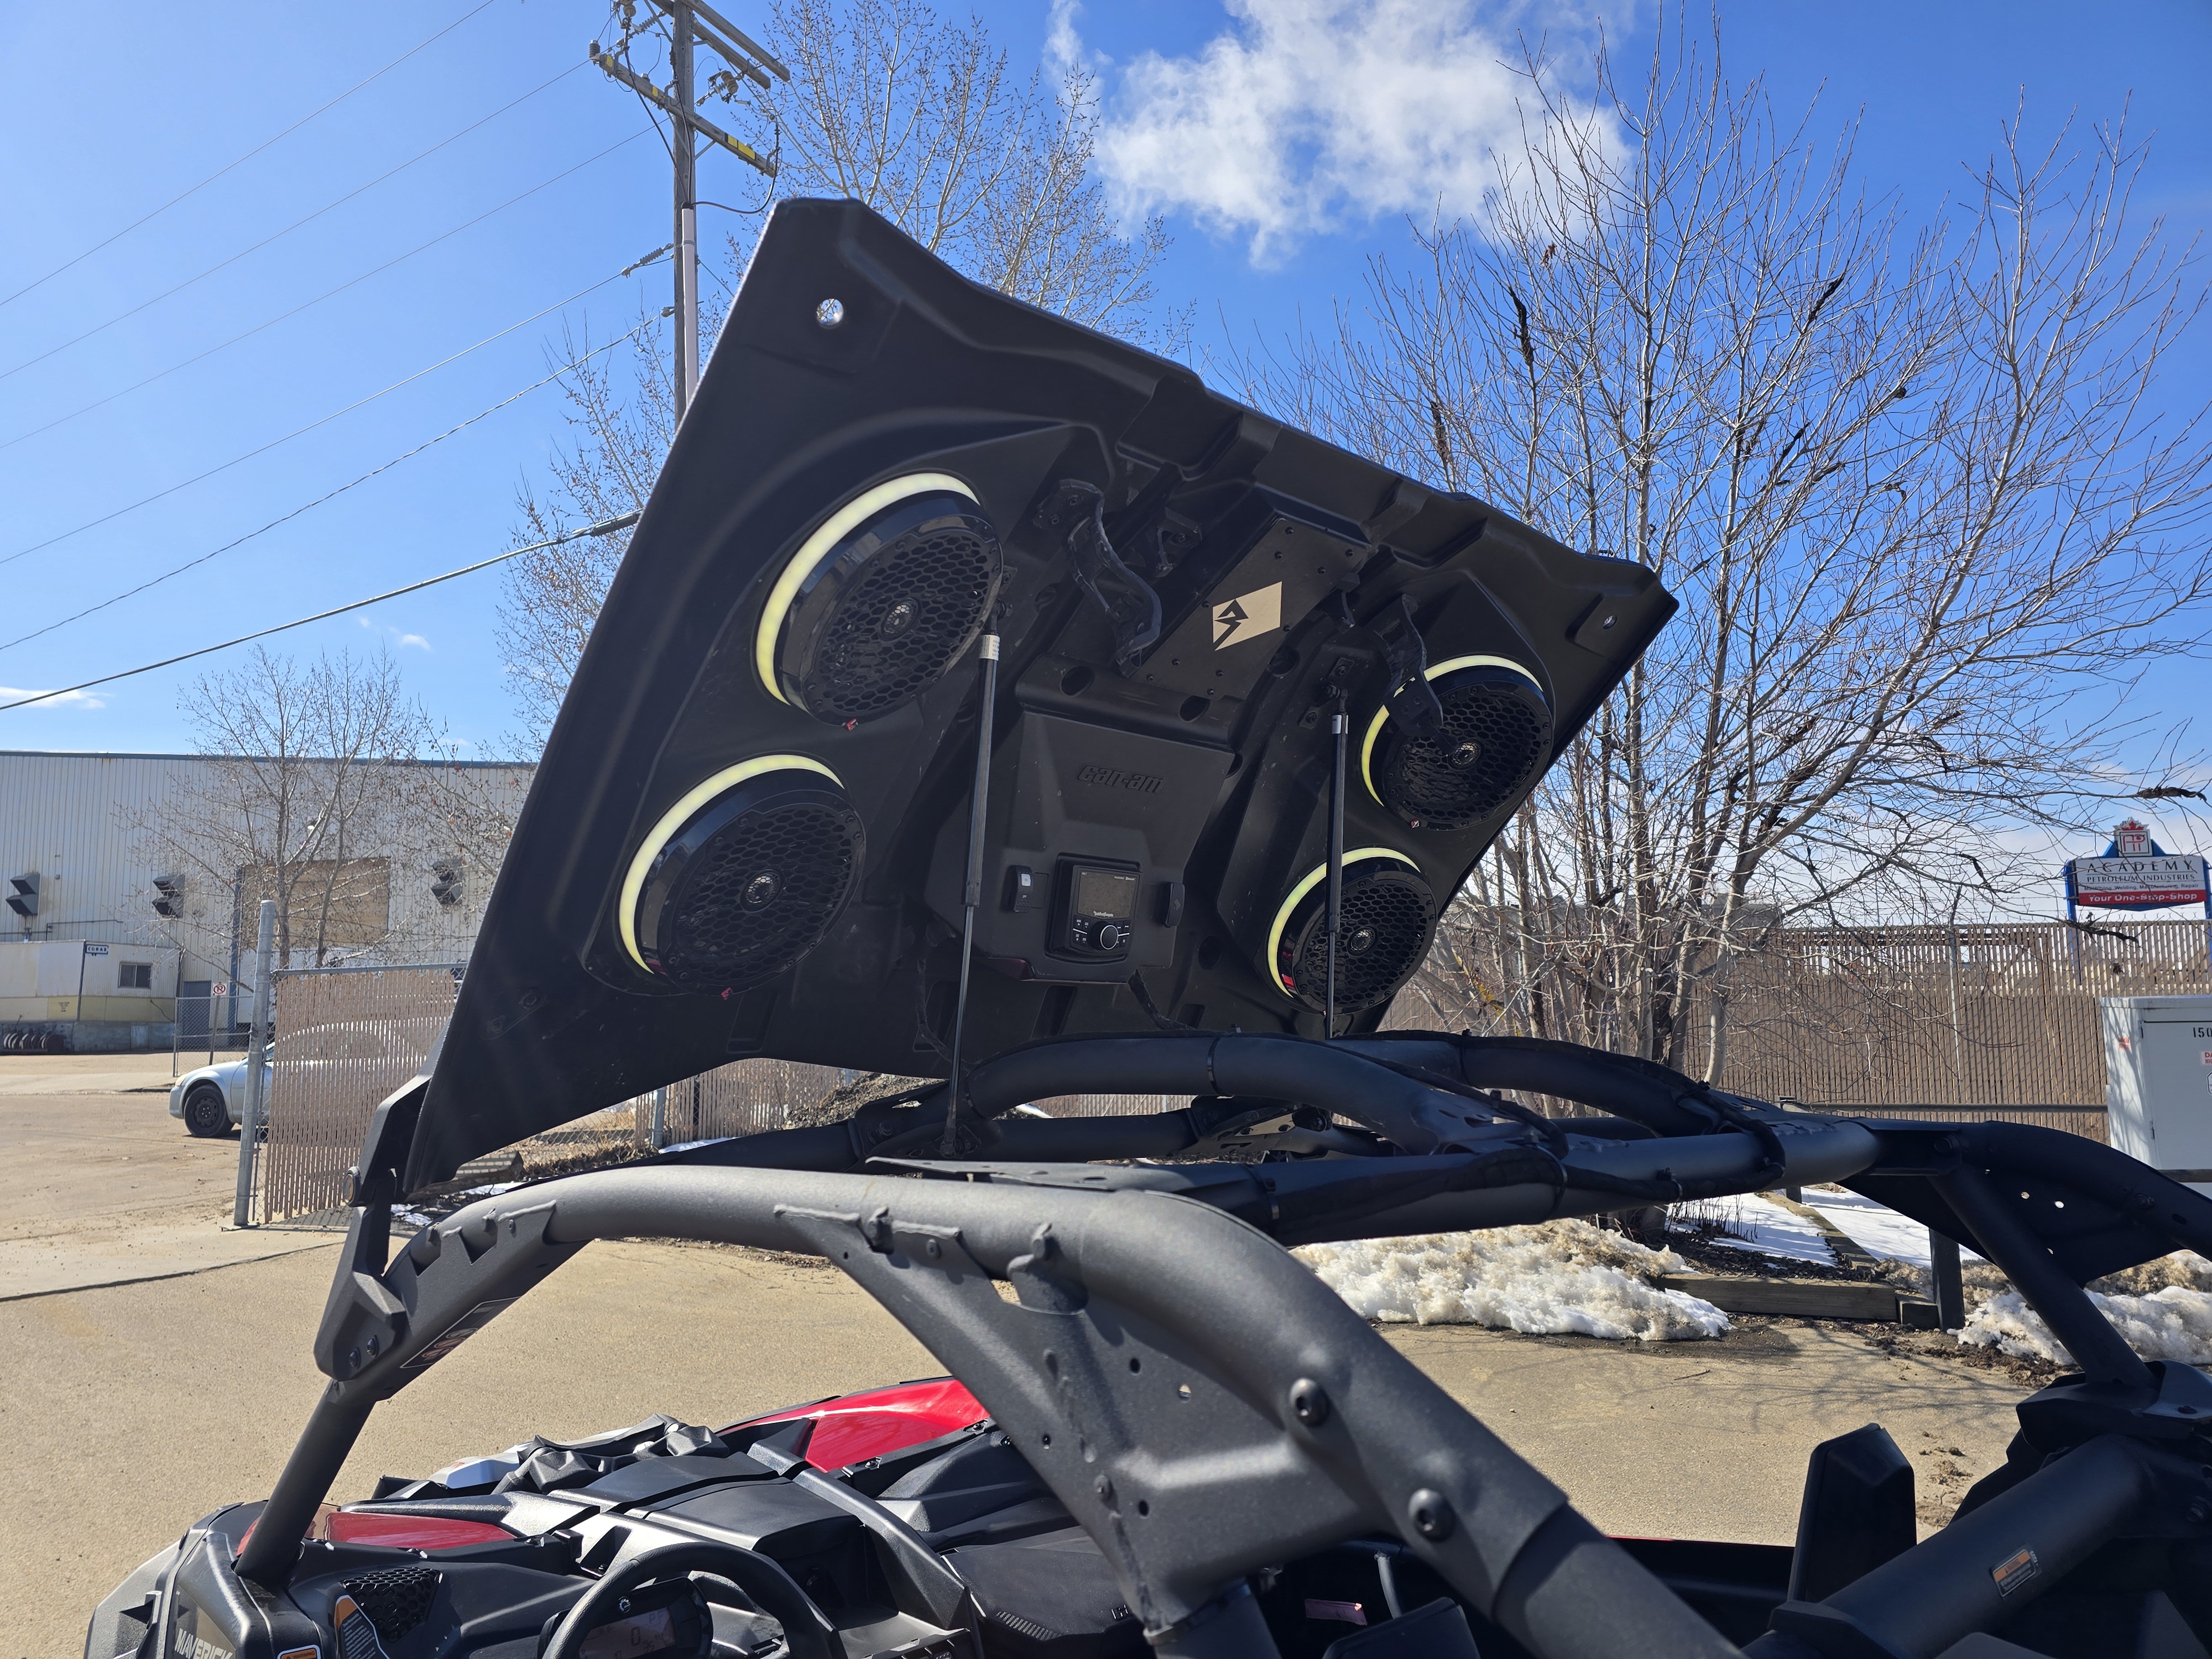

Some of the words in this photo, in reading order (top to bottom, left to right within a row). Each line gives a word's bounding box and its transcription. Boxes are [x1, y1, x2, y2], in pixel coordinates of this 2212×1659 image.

[1078, 765, 1166, 793] can-am
[2088, 860, 2192, 873] ACADEMY
[2115, 893, 2198, 902] One-Stop-Shop
